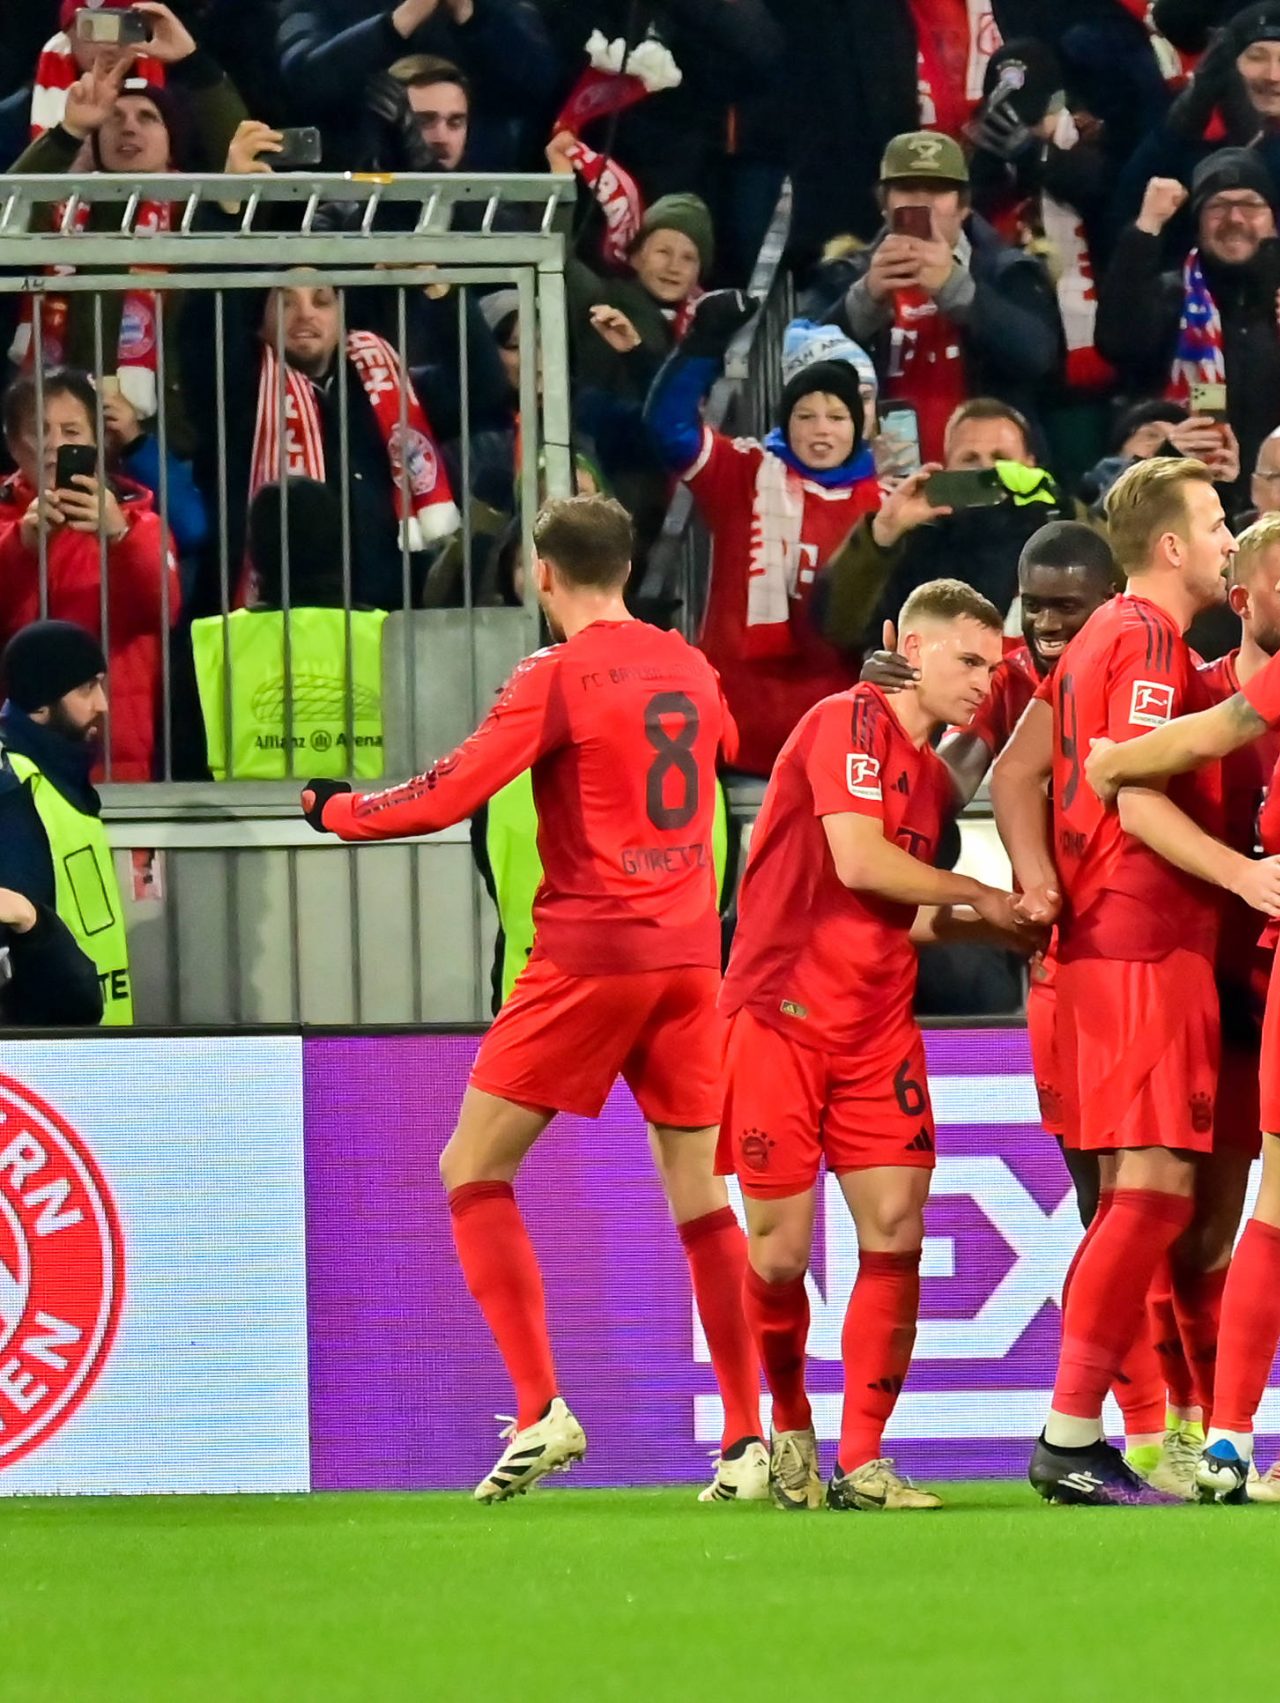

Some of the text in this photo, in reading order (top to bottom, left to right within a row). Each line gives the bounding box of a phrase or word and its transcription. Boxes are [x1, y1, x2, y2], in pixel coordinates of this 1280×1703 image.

[335, 733, 385, 748] Aena
[643, 691, 699, 831] 8
[893, 1060, 926, 1117] 6
